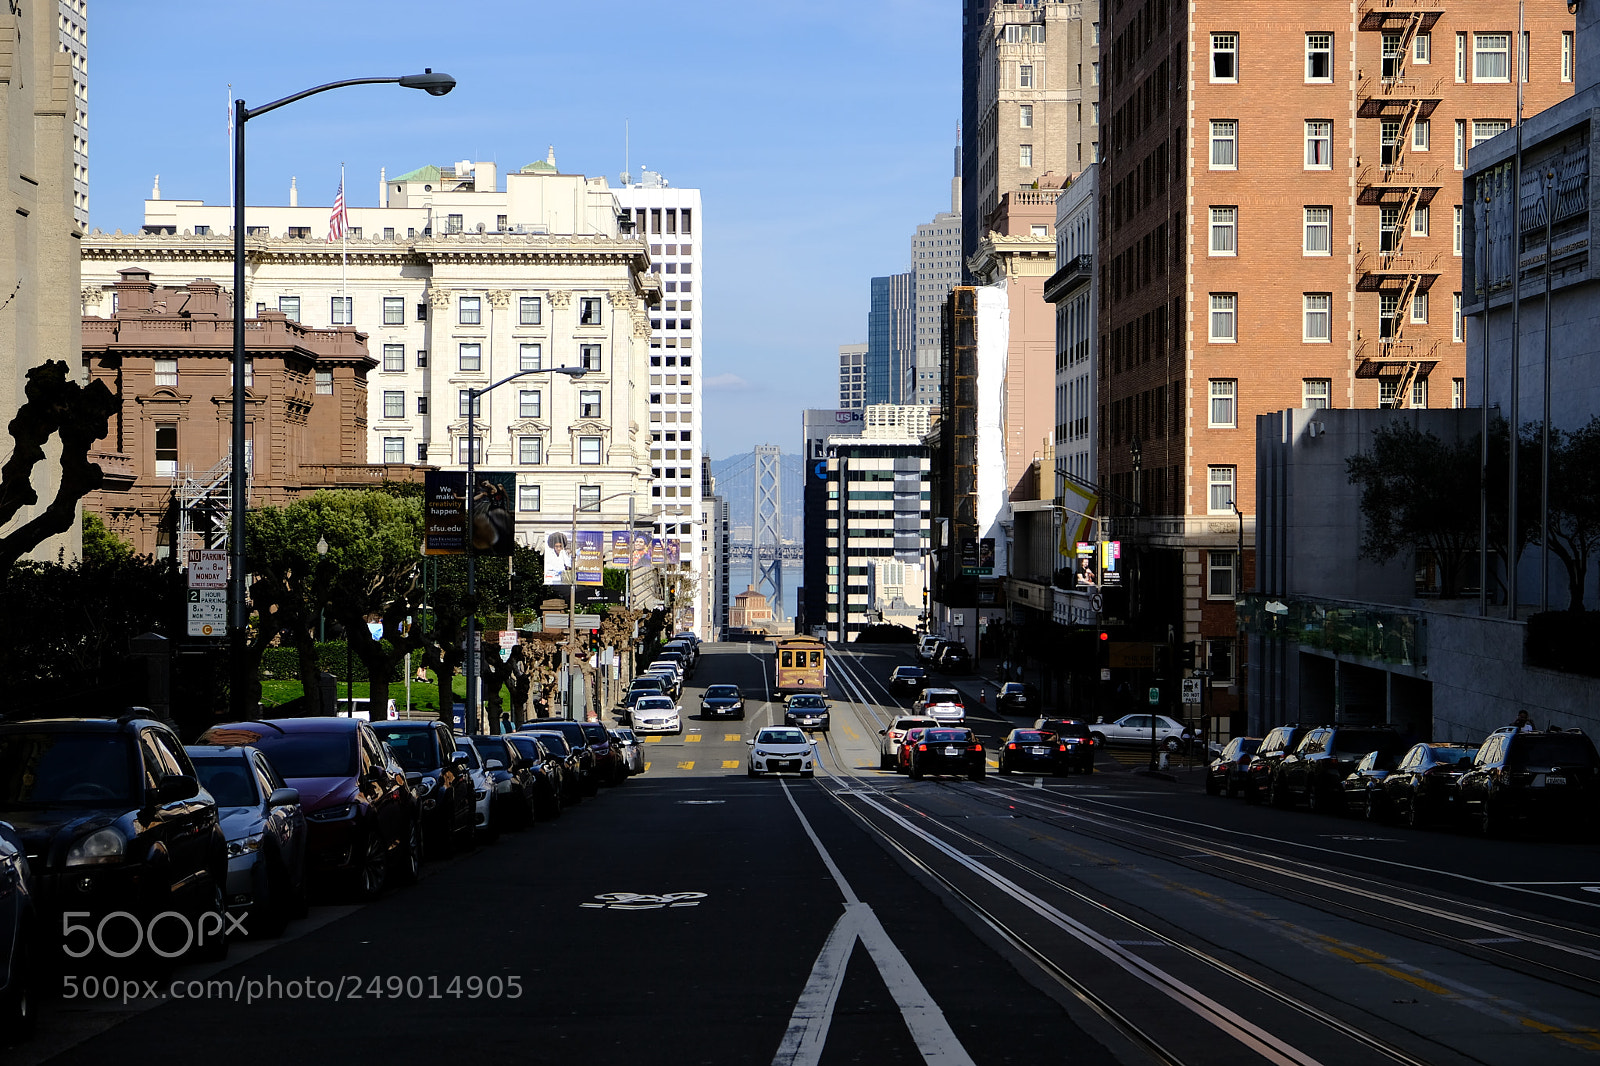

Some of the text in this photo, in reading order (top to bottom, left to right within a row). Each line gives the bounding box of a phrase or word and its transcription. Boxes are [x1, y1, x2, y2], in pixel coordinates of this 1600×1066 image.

[430, 508, 460, 516] happen.
[190, 551, 226, 561] NO PARKING
[190, 591, 197, 600] 2
